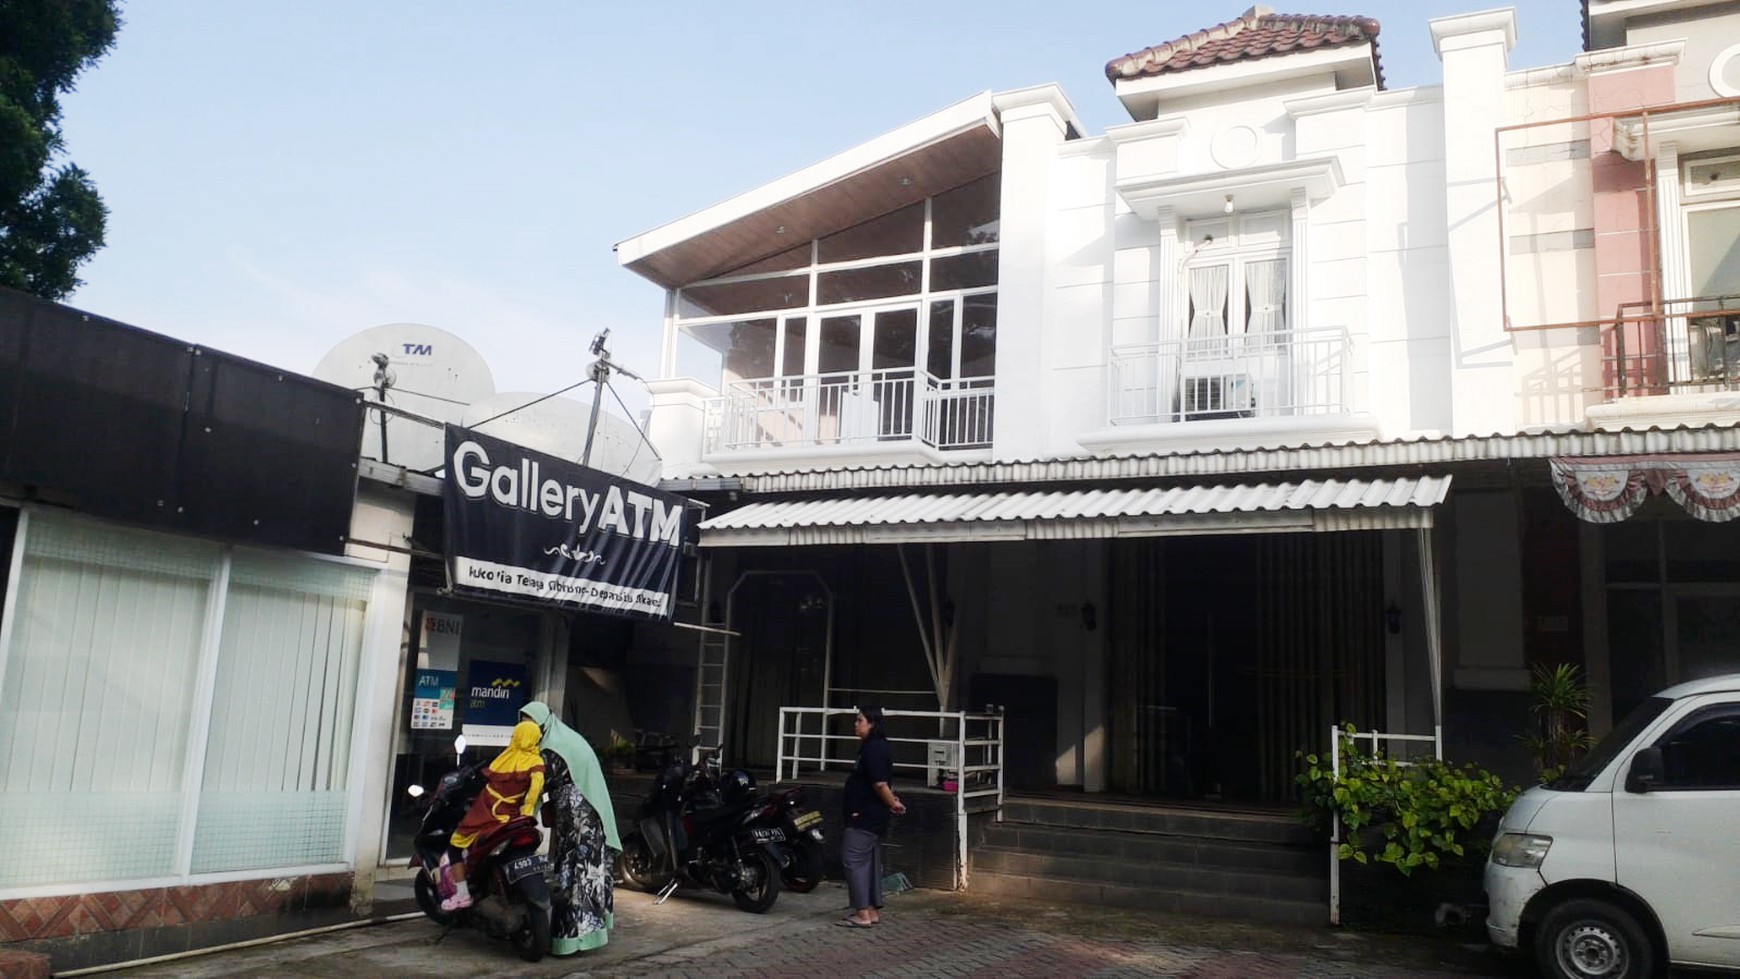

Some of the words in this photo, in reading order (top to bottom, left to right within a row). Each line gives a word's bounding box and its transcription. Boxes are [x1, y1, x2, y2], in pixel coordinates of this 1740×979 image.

[402, 343, 433, 356] TM
[436, 618, 460, 635] BNI
[418, 675, 440, 688] ATM
[471, 684, 510, 700] mandiri
